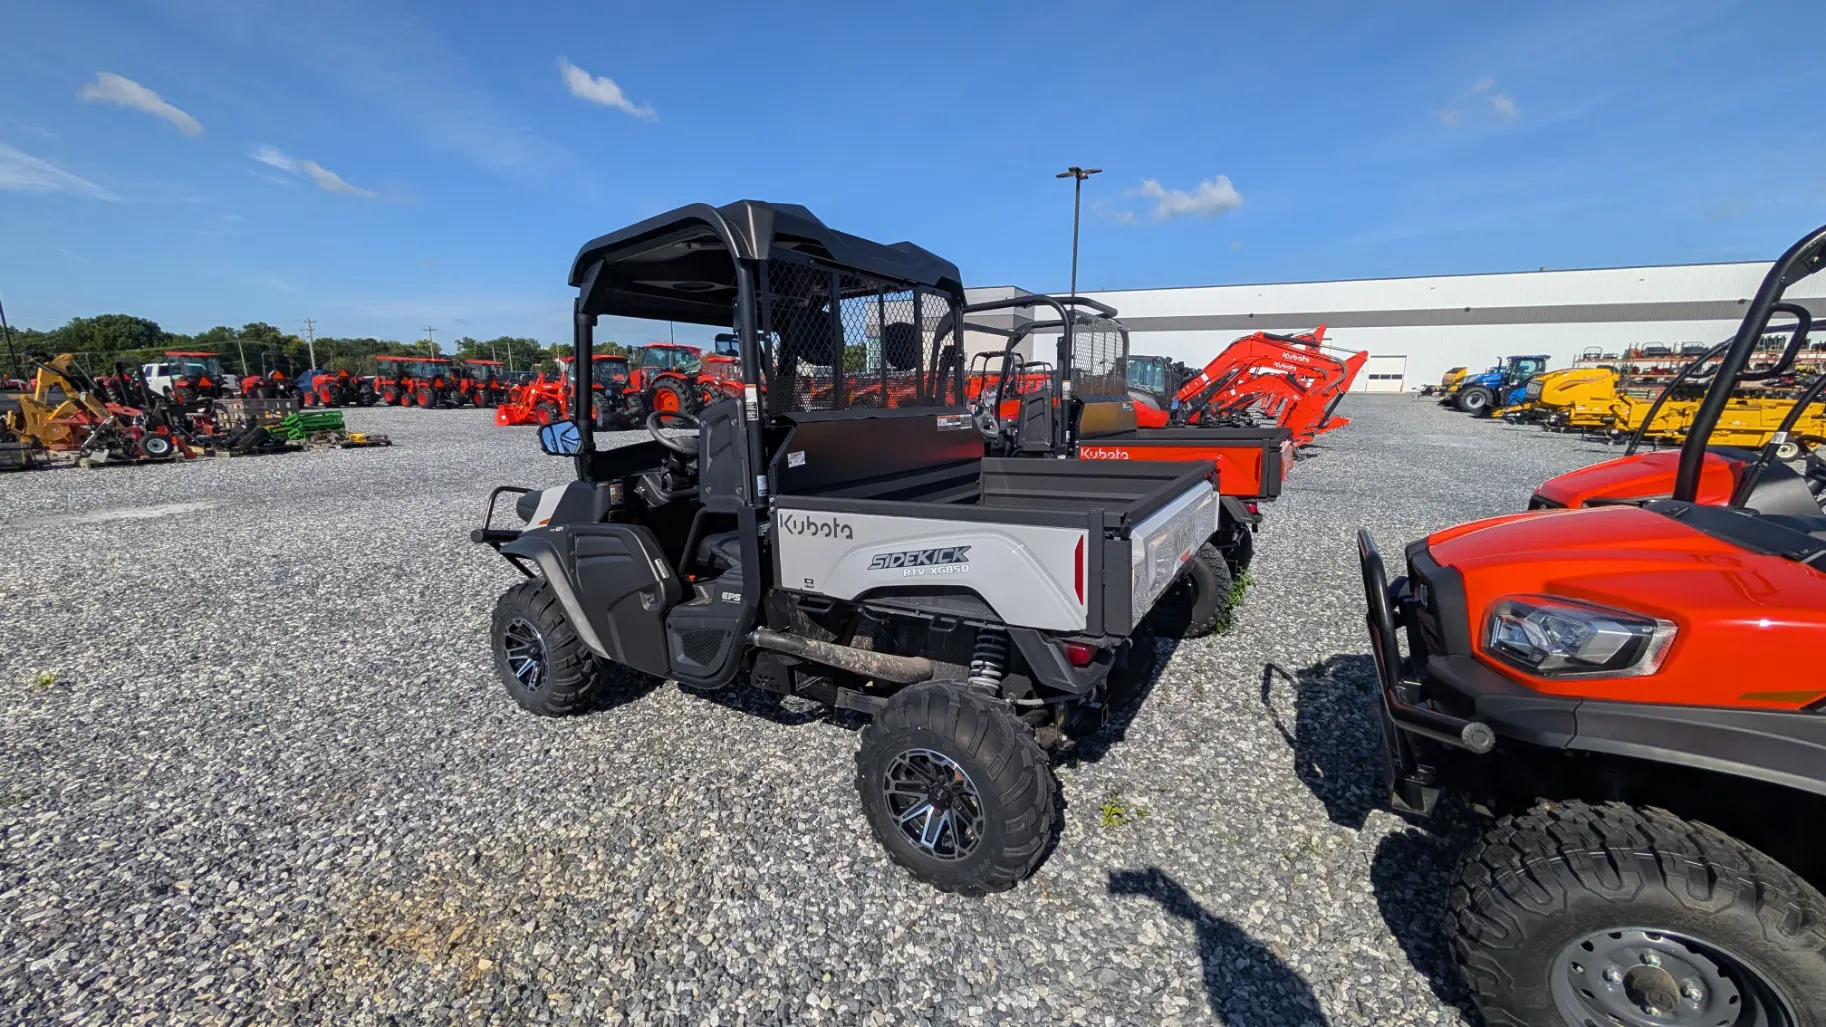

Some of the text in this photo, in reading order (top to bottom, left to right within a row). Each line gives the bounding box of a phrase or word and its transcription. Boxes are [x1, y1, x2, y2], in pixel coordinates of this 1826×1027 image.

[1282, 352, 1310, 363] Kubota
[1080, 448, 1129, 460] Kubota
[780, 513, 853, 540] Kubota
[867, 545, 972, 571] SIDEKICK
[930, 564, 969, 575] XG850
[721, 591, 742, 602] EPS
